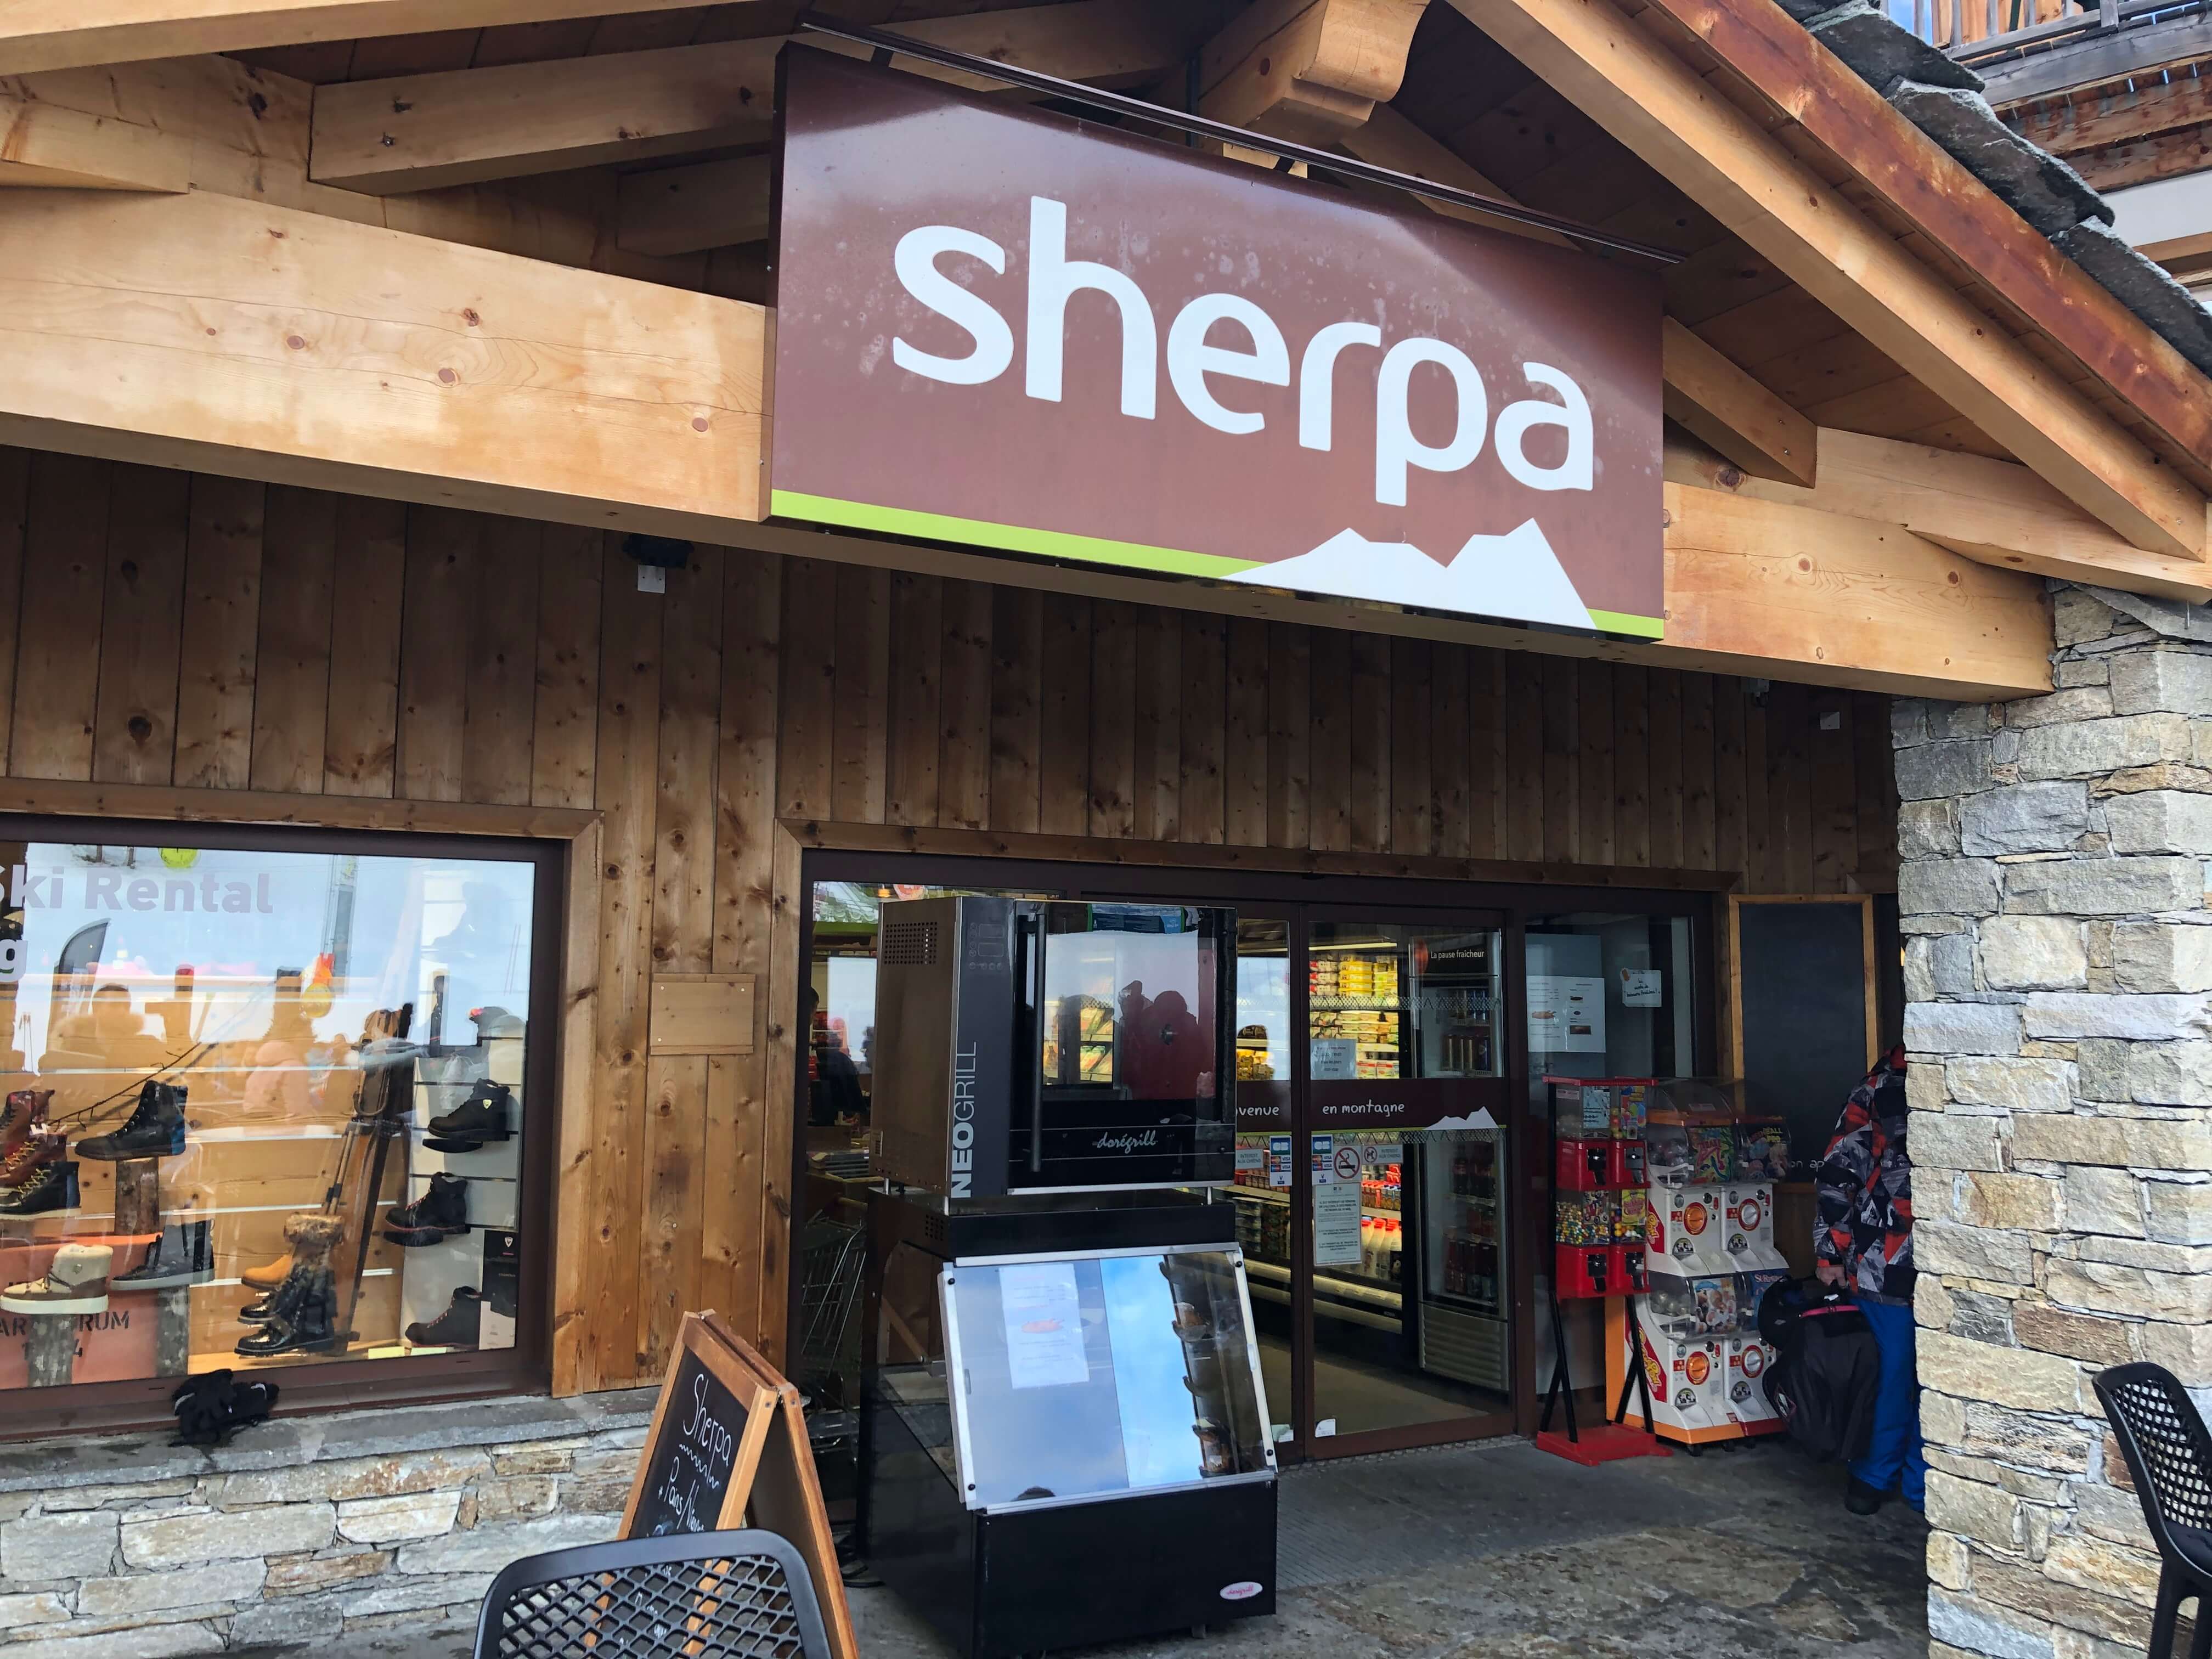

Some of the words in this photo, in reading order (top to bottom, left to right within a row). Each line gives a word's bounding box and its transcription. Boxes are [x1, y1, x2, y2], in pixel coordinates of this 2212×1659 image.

[892, 195, 1594, 507] sherpa
[0, 864, 64, 909] ki
[84, 871, 273, 913] Rental
[1438, 952, 1455, 961] pause
[950, 1041, 977, 1199] NEOGRILL
[1235, 1105, 1280, 1116] venue
[1322, 1105, 1338, 1115] en
[1341, 1099, 1406, 1118] montagne
[683, 1373, 732, 1483] Sherpa
